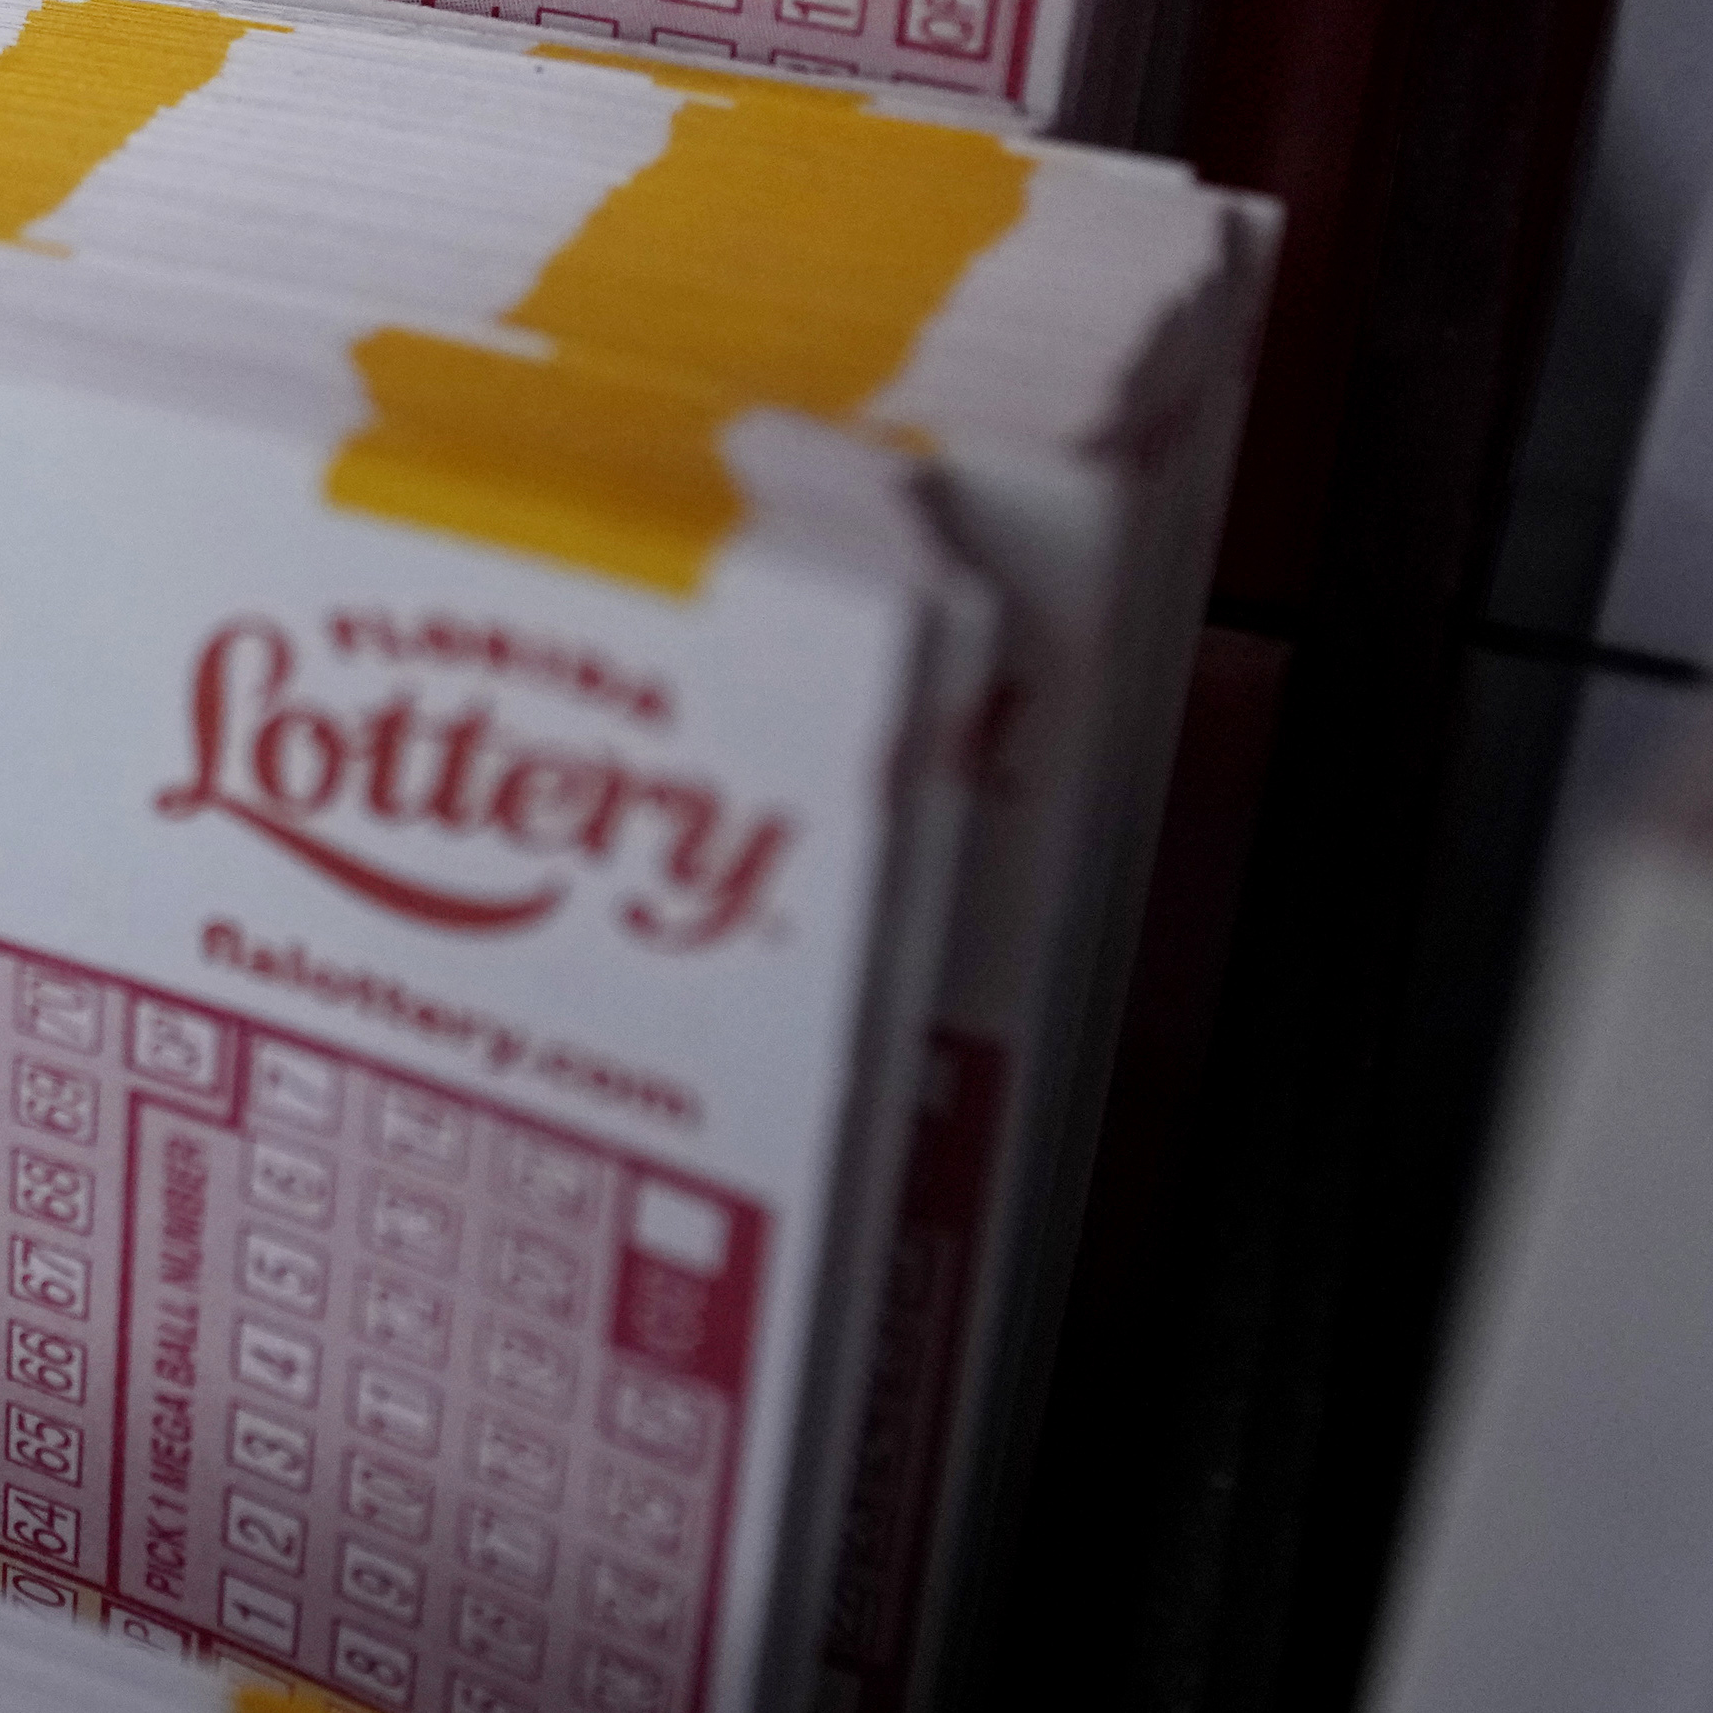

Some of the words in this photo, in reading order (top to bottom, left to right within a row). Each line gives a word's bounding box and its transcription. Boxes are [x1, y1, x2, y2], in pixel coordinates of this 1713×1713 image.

[154, 611, 792, 951] Lottery
[20, 1245, 77, 1307] 67
[18, 1332, 74, 1392] 66
[16, 1414, 72, 1473] 65
[15, 1497, 68, 1552] 64
